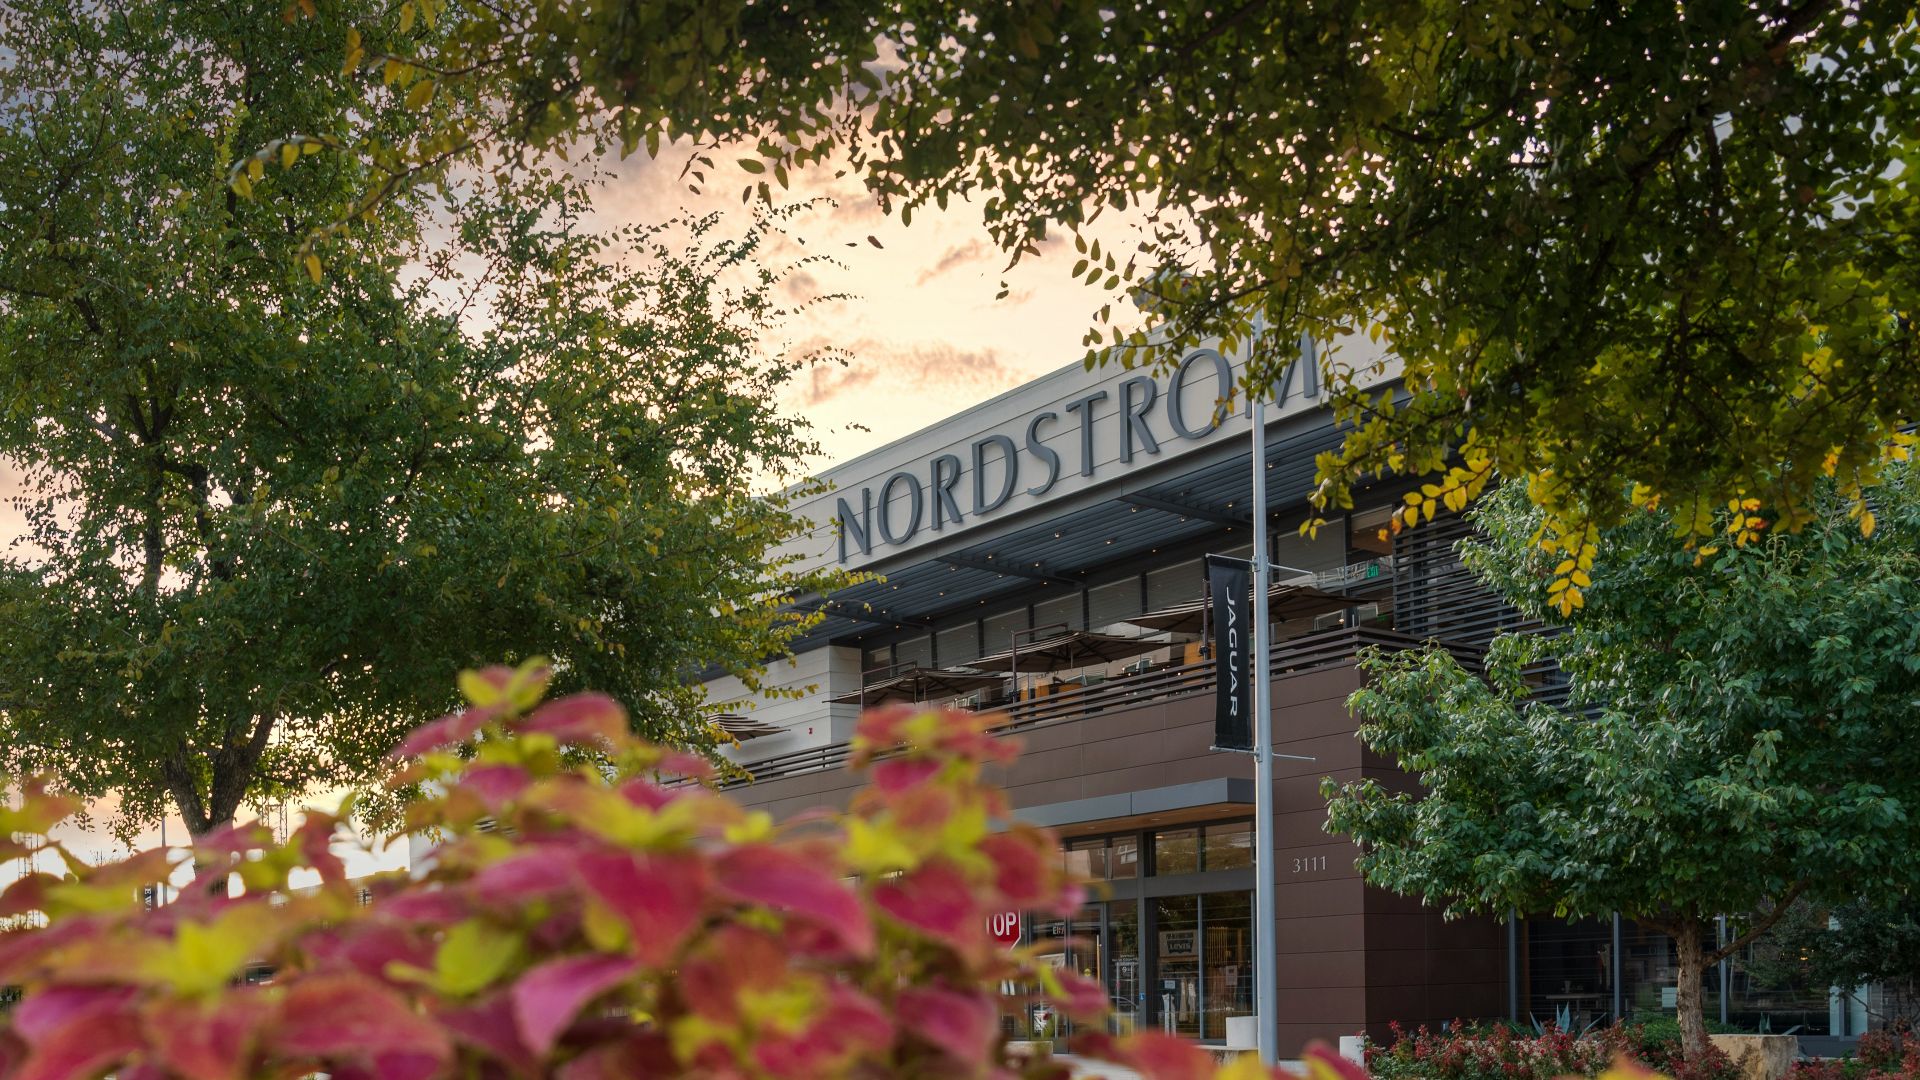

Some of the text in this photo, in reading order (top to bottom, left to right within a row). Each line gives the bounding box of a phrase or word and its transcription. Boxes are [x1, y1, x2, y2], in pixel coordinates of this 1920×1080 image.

[837, 322, 1319, 564] NORDSTROM
[1226, 586, 1238, 717] JAGUAR
[1292, 855, 1326, 873] 3111
